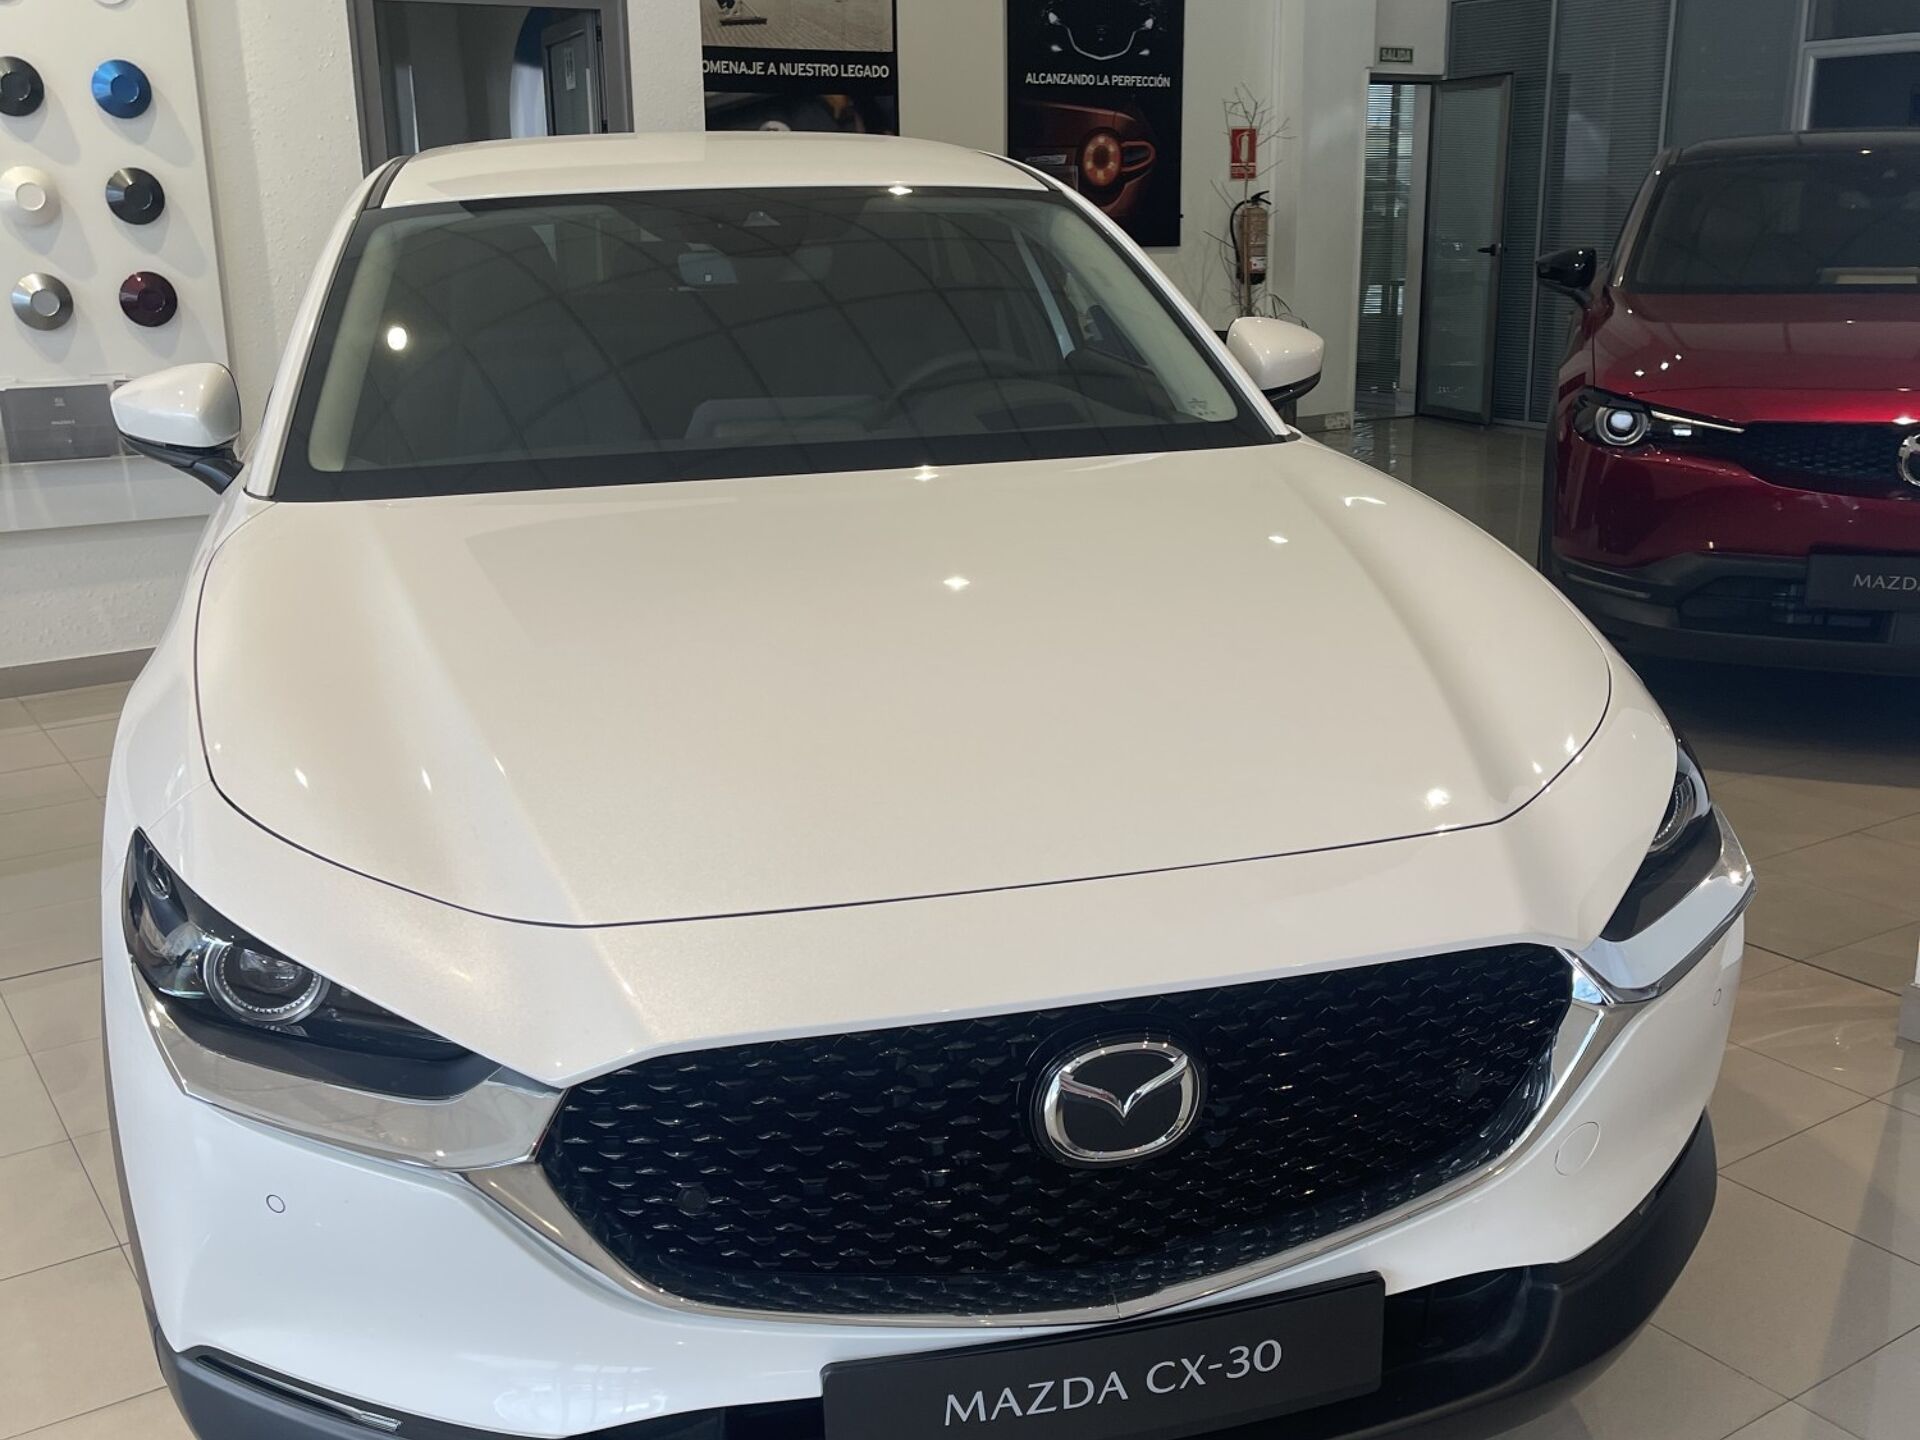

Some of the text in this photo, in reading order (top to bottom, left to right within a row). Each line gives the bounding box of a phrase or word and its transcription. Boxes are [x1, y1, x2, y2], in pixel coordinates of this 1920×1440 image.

[702, 59, 890, 78] OMENAJE A NUESTRO LEGADO
[1025, 72, 1171, 87] ALCANZANDO LA PERFECCIÓN
[1852, 573, 1920, 591] MAZD
[944, 1339, 1282, 1426] MAZDA CX-30
